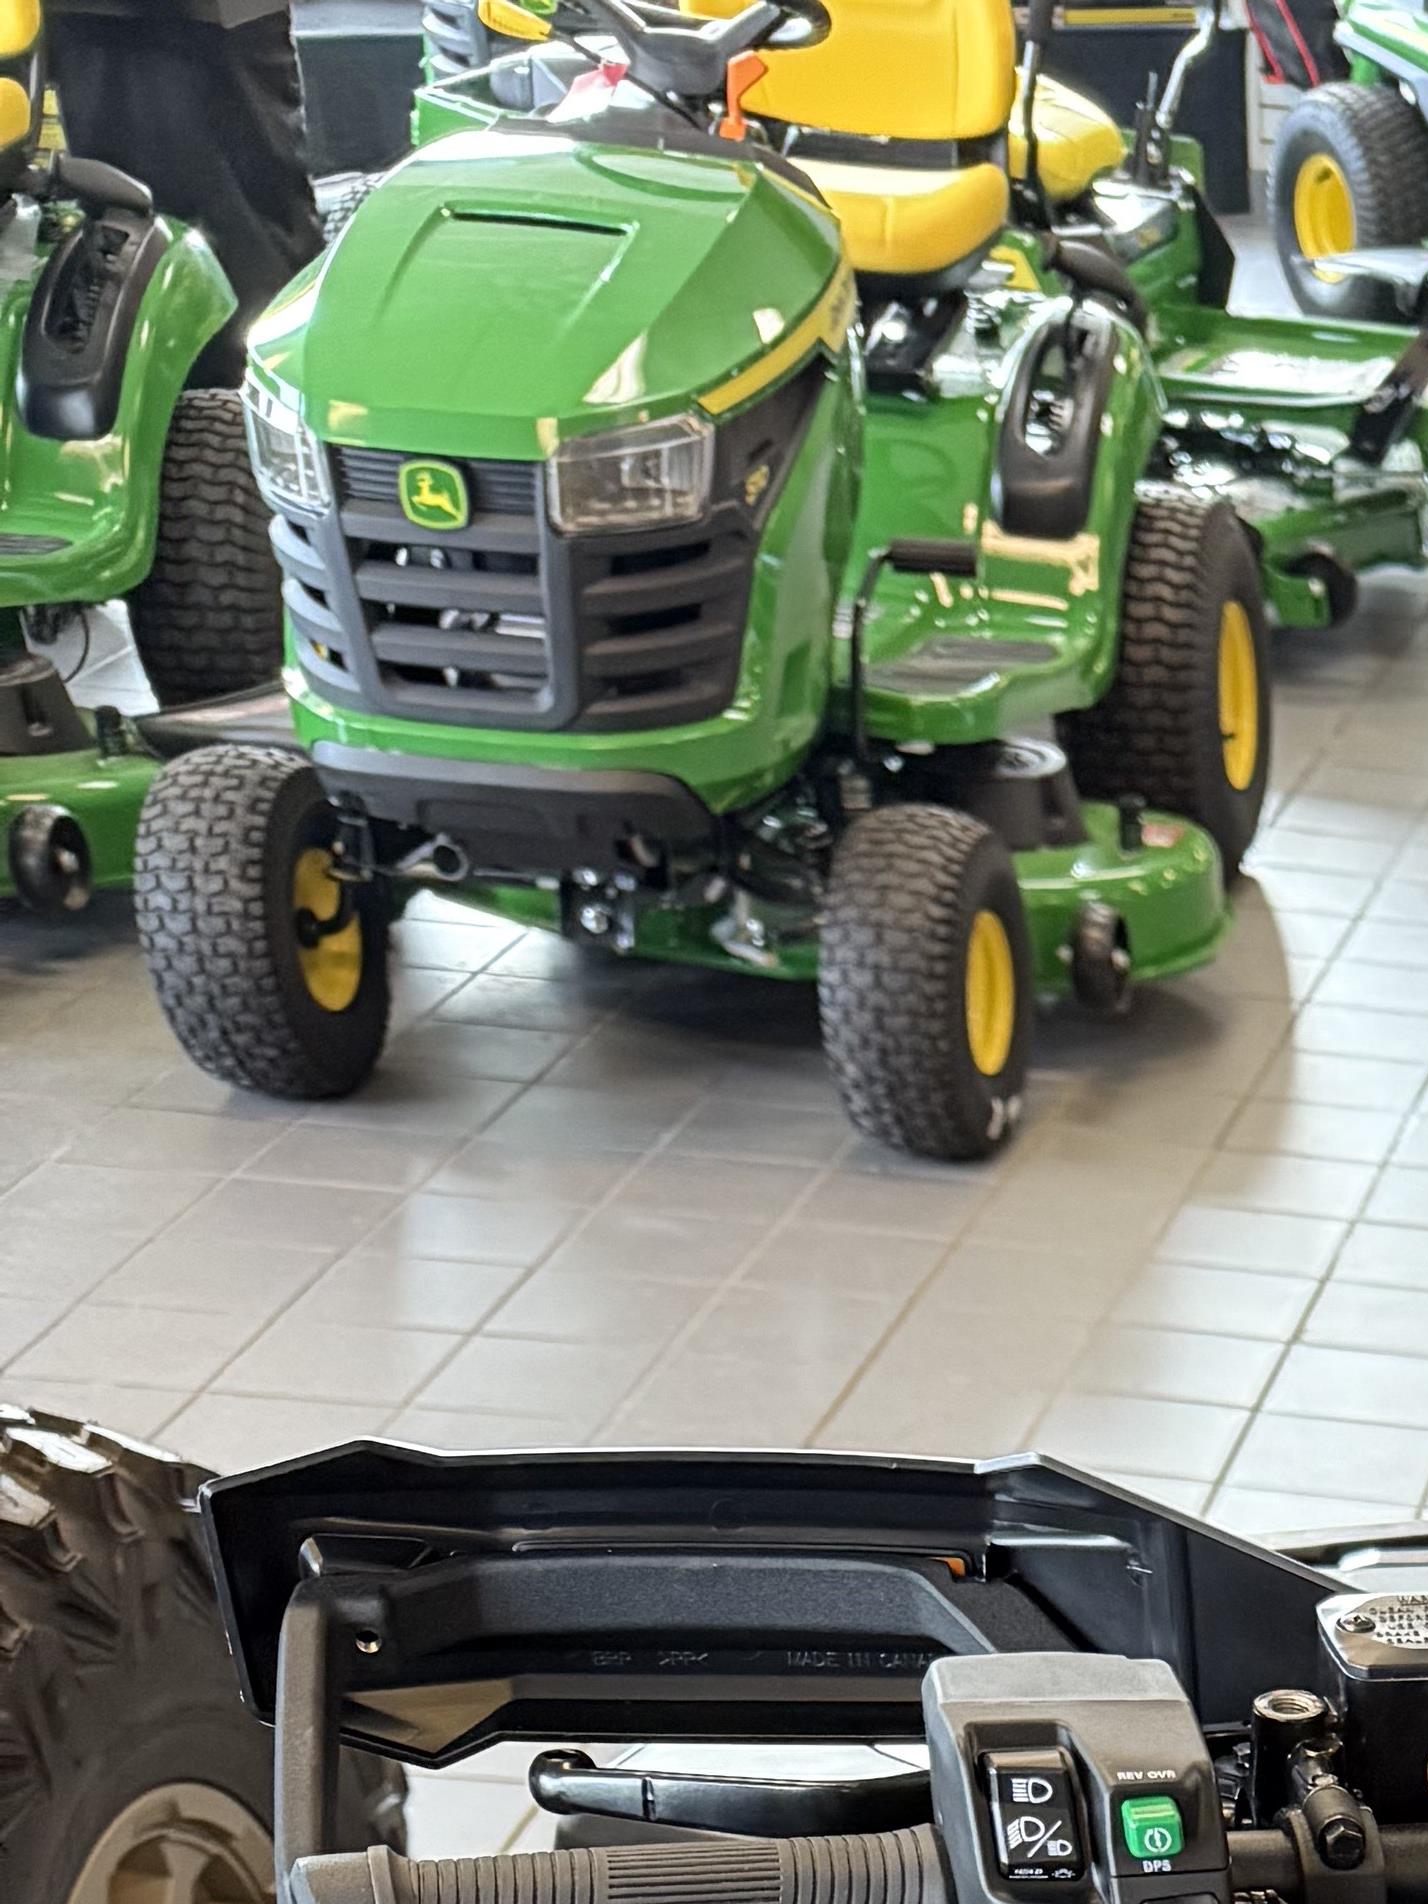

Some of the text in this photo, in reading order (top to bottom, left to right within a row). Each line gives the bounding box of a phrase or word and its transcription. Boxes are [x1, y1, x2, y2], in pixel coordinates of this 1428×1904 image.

[1117, 1770, 1176, 1781] REV OVR
[1142, 1860, 1173, 1873] DPS
